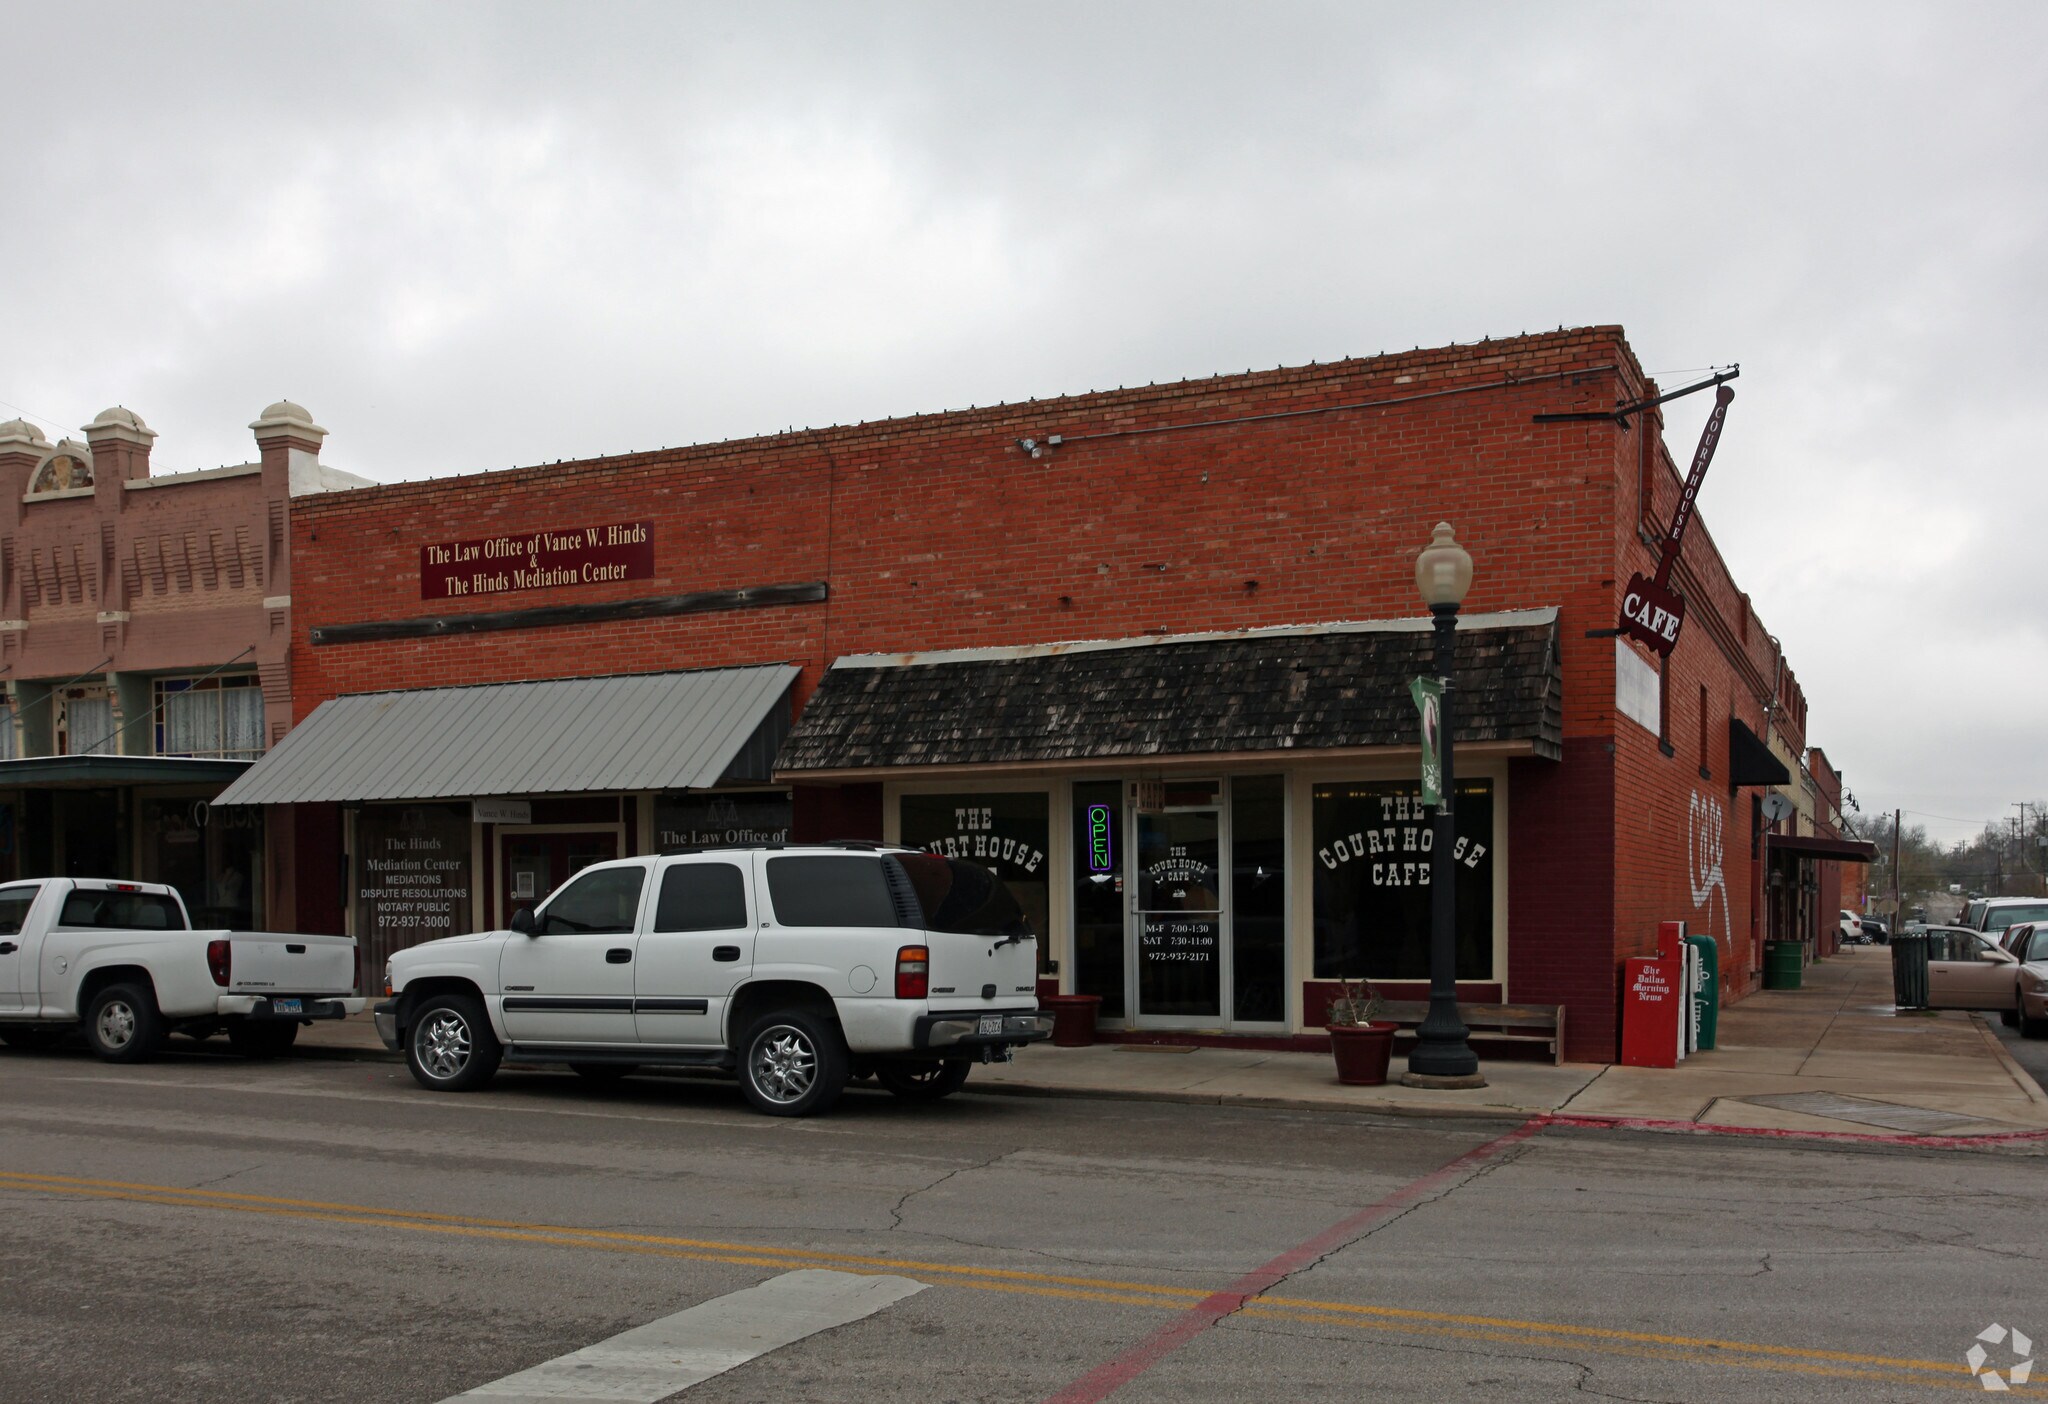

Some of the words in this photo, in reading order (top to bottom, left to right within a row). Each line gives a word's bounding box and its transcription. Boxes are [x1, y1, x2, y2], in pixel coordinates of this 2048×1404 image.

[1672, 406, 1724, 540] COURTHOUSE
[427, 546, 450, 565] The
[454, 543, 481, 563] Law
[484, 539, 523, 559] Office
[527, 534, 541, 554] of
[543, 532, 582, 552] Vance
[586, 528, 603, 547] W.
[607, 523, 647, 545] Hinds
[529, 554, 538, 568] &
[445, 576, 469, 596] The
[473, 572, 509, 593] Hinds
[513, 566, 578, 589] Mediation
[582, 562, 627, 583] Center
[1623, 592, 1680, 643] CAFE
[478, 808, 497, 818] Vance
[510, 809, 530, 819] Hinds
[1381, 796, 1425, 821] THE
[955, 807, 992, 830] THE
[660, 830, 687, 845] The
[691, 830, 722, 845] Law
[725, 828, 769, 844] Office
[772, 828, 788, 843] of
[1091, 808, 1107, 867] OPEN
[385, 838, 407, 850] The
[410, 837, 442, 850] Hinds
[1318, 826, 1487, 870] COURTHOSE
[1170, 846, 1187, 857] THE
[367, 858, 421, 871] Mediation
[424, 858, 461, 871] Center
[385, 874, 442, 885] MEDIATIONS
[1167, 871, 1190, 882] CAFE
[1372, 862, 1431, 887] CAFE
[360, 888, 400, 899] DISPUTE
[401, 888, 467, 899] RESOLUTIONS
[377, 902, 414, 912] NOTARY
[416, 902, 451, 912] PUBLIC
[378, 915, 451, 928] 972-937-3000
[1143, 936, 1163, 946] SAT
[1148, 952, 1210, 962] 972-937-2171
[1642, 965, 1661, 975] The
[1637, 974, 1666, 984] Dallas
[1632, 983, 1670, 994] Morning
[1638, 992, 1663, 1002] News
